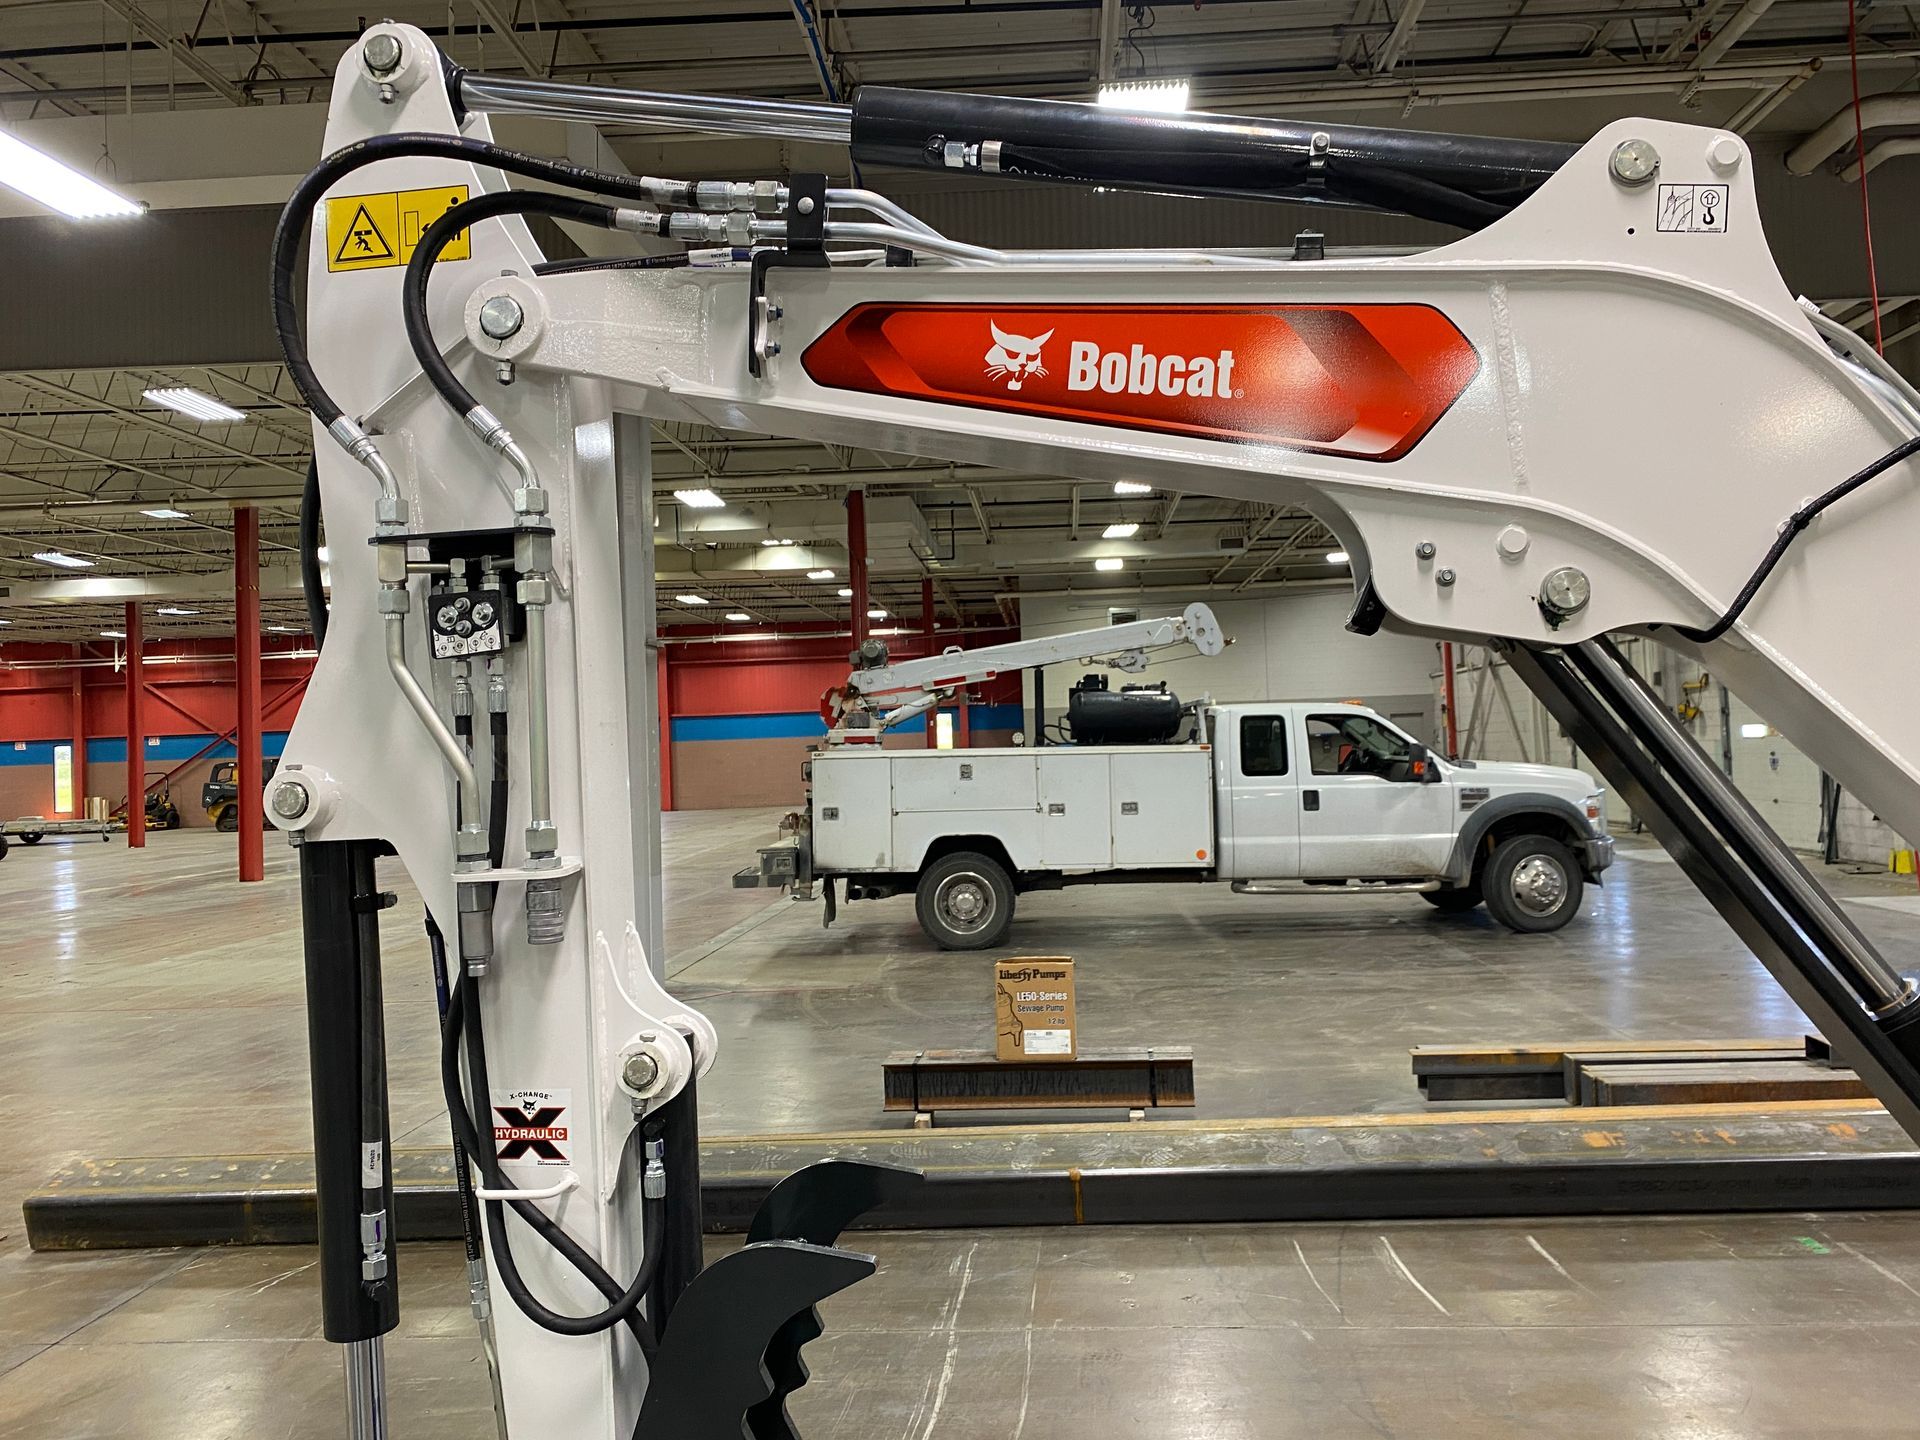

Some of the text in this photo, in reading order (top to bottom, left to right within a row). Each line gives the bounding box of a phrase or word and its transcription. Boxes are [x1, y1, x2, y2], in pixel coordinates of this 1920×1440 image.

[1067, 341, 1235, 399] Bobcat
[999, 968, 1067, 982] Liberty Pumps
[1017, 1004, 1065, 1013] Sewage Pump
[495, 1129, 565, 1139] HYDRAULIC
